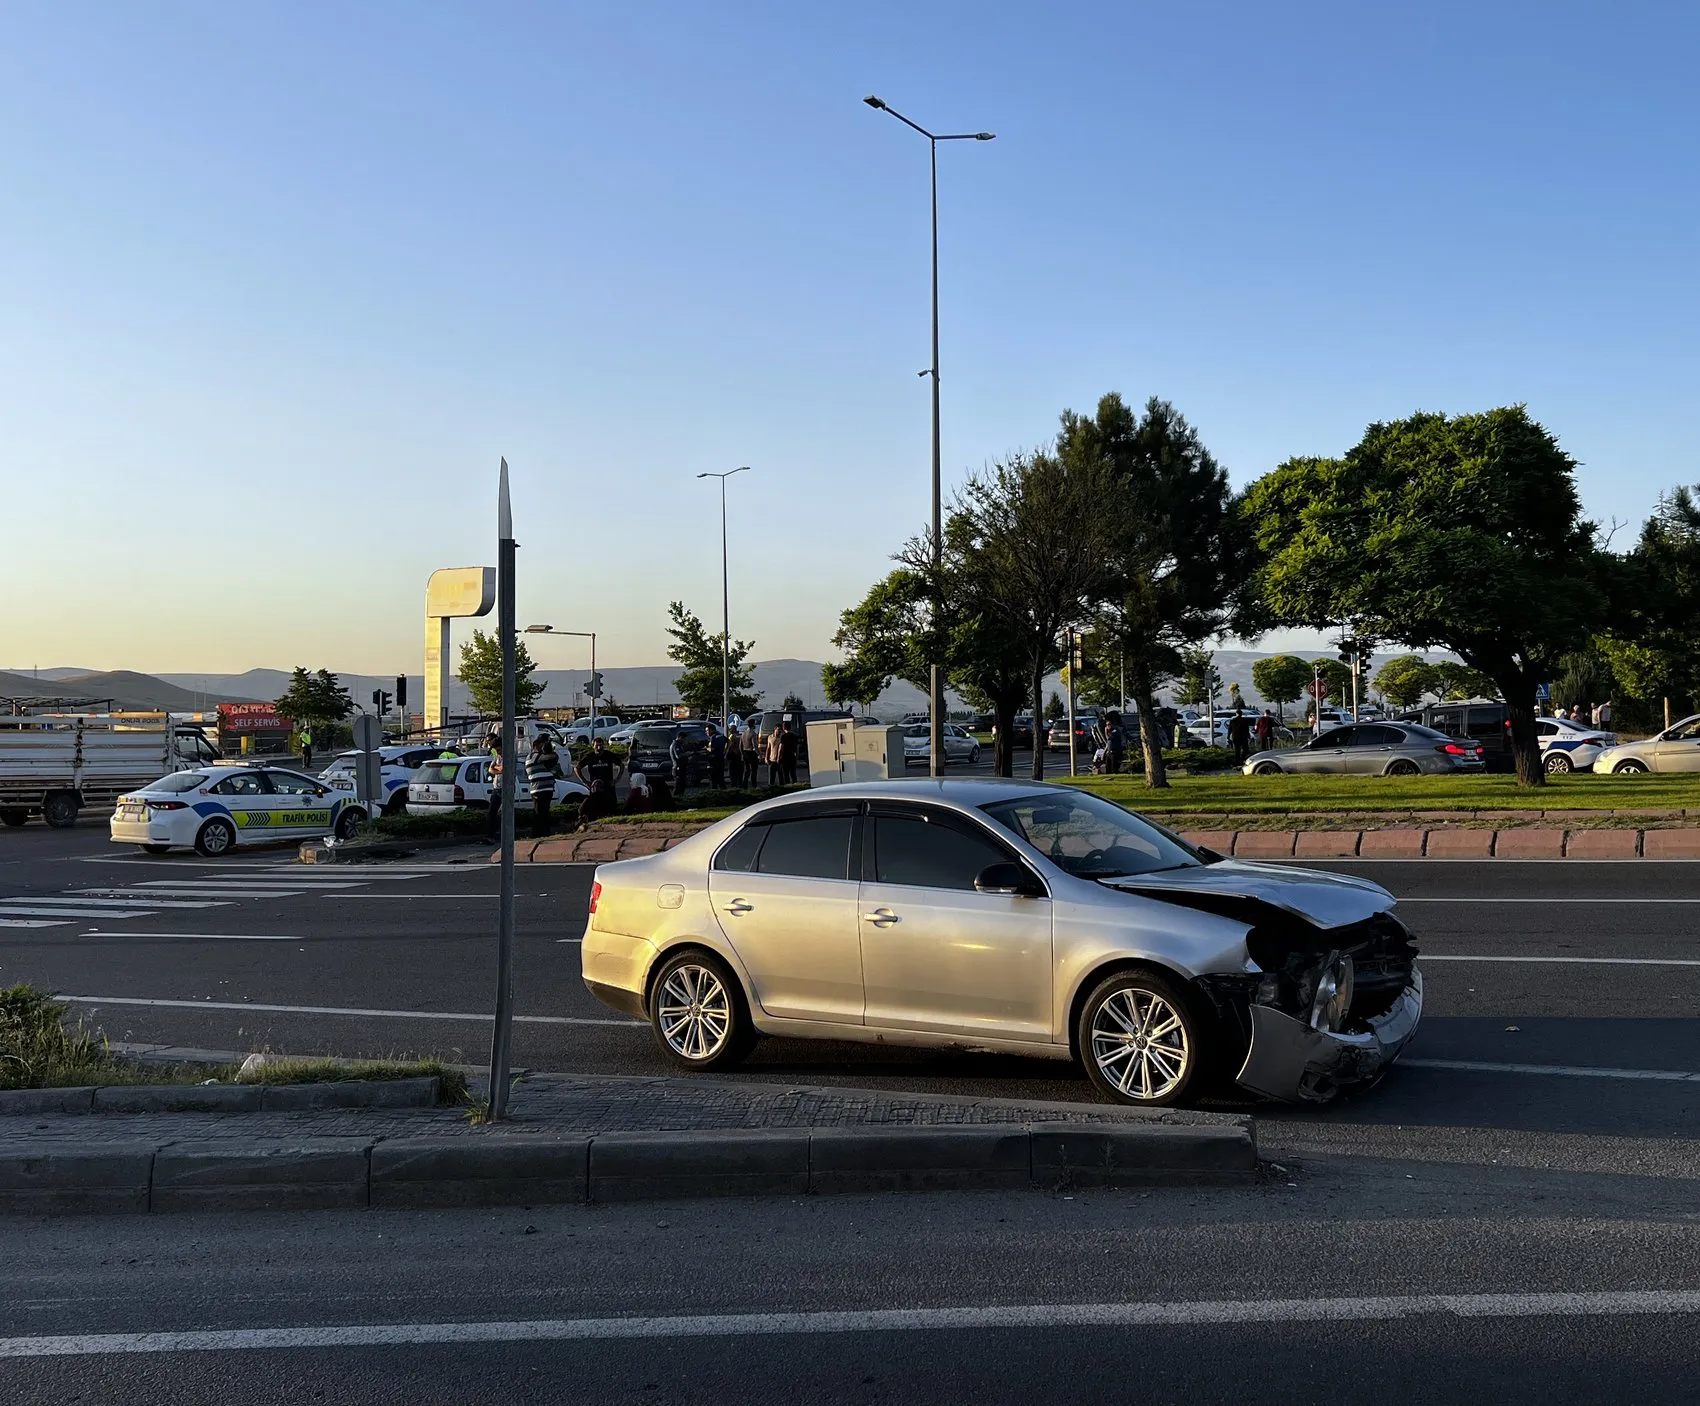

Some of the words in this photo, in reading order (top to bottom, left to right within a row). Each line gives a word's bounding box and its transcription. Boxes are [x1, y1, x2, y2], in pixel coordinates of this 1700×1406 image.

[234, 718, 252, 727] SELF
[282, 812, 305, 823] TRAFİK
[306, 811, 328, 823] POLİSİ
